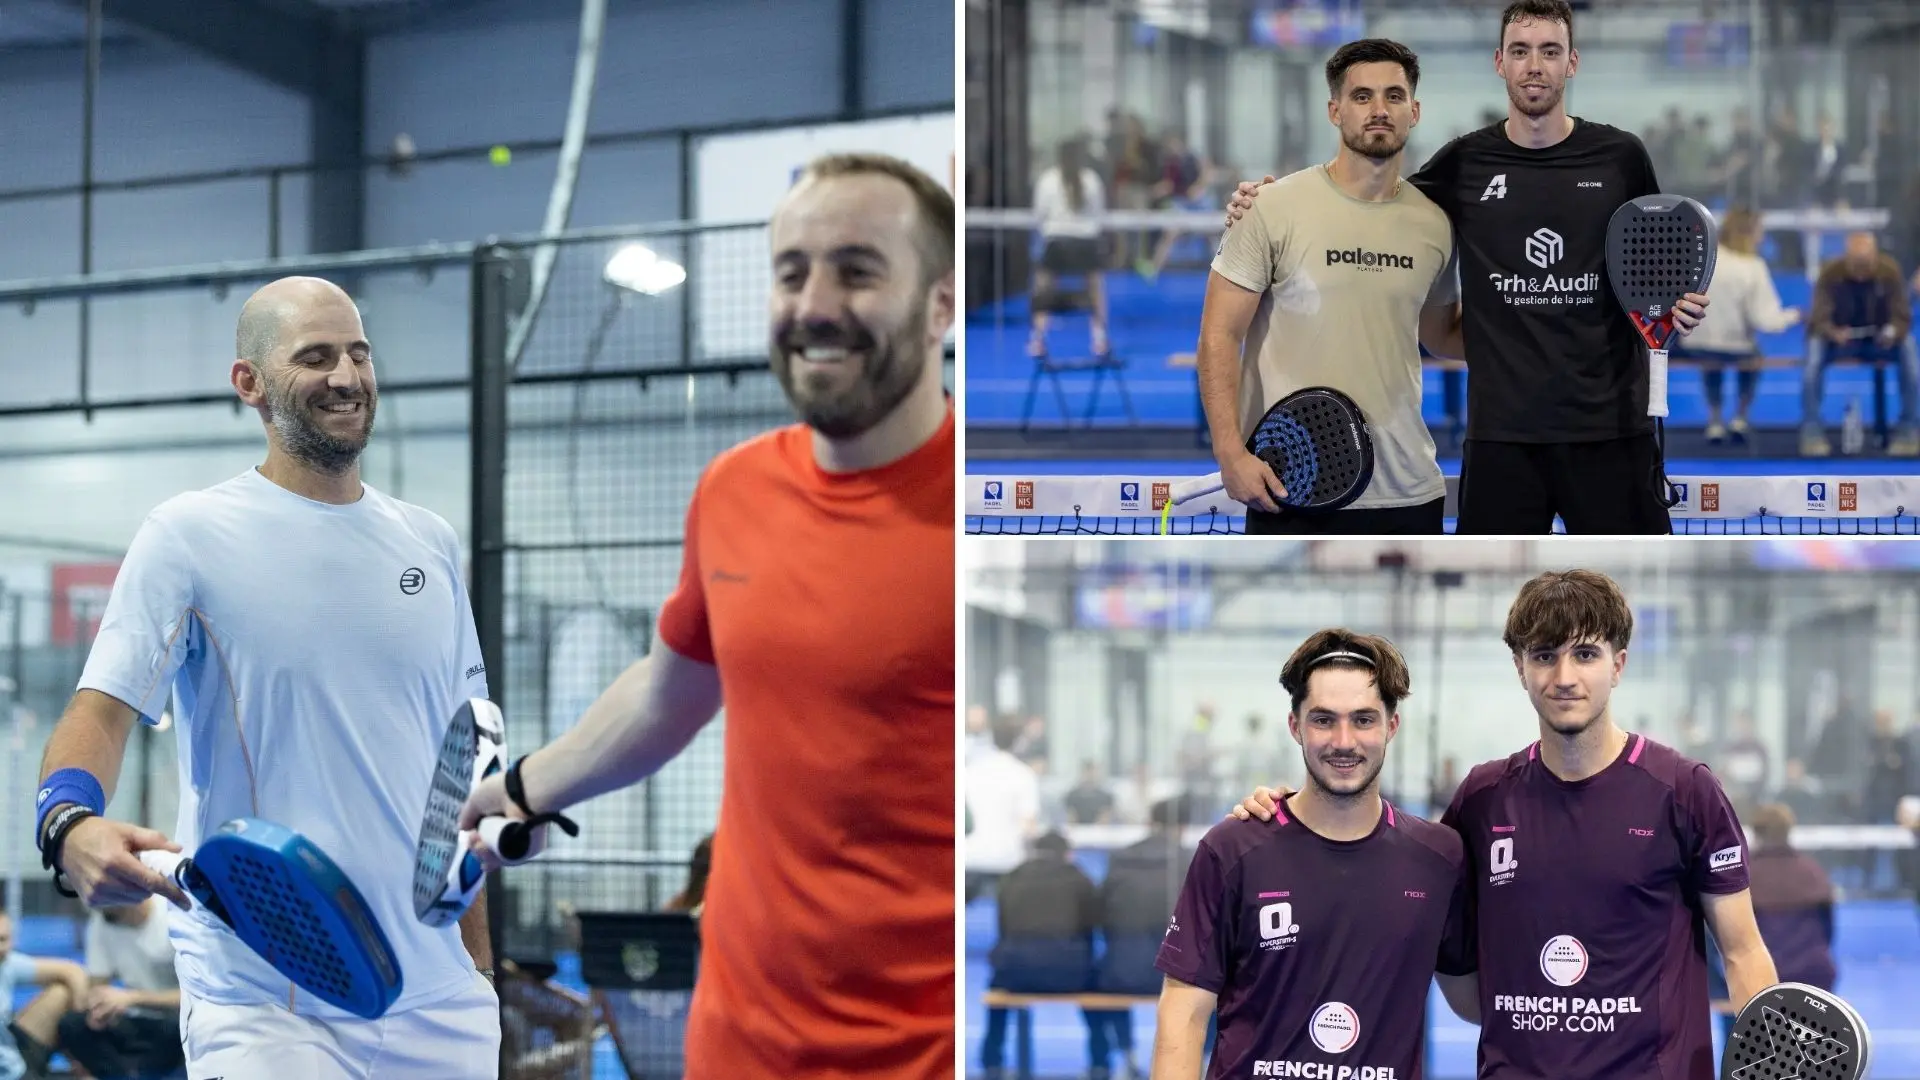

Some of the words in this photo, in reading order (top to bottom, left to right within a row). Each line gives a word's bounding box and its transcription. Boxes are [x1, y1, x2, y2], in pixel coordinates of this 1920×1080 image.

[1326, 247, 1414, 270] paloma
[1504, 294, 1512, 304] la
[1514, 296, 1549, 306] gestion
[1551, 294, 1563, 304] de
[1565, 294, 1574, 304] la
[1576, 294, 1594, 306] paie
[1018, 484, 1031, 494] TEN
[1154, 486, 1168, 495] TEN
[1703, 487, 1717, 496] TEN
[1841, 486, 1855, 495] TEN
[1018, 498, 1031, 506] NIS
[1703, 499, 1717, 509] NIS
[1841, 499, 1855, 508] NIS
[1714, 851, 1737, 862] Krys
[1494, 994, 1567, 1014] FRENCH
[1572, 996, 1642, 1014] PADEL
[1803, 995, 1828, 1012] nox
[1253, 1060, 1334, 1080] FRENCH
[1337, 1066, 1398, 1080] PADEL
